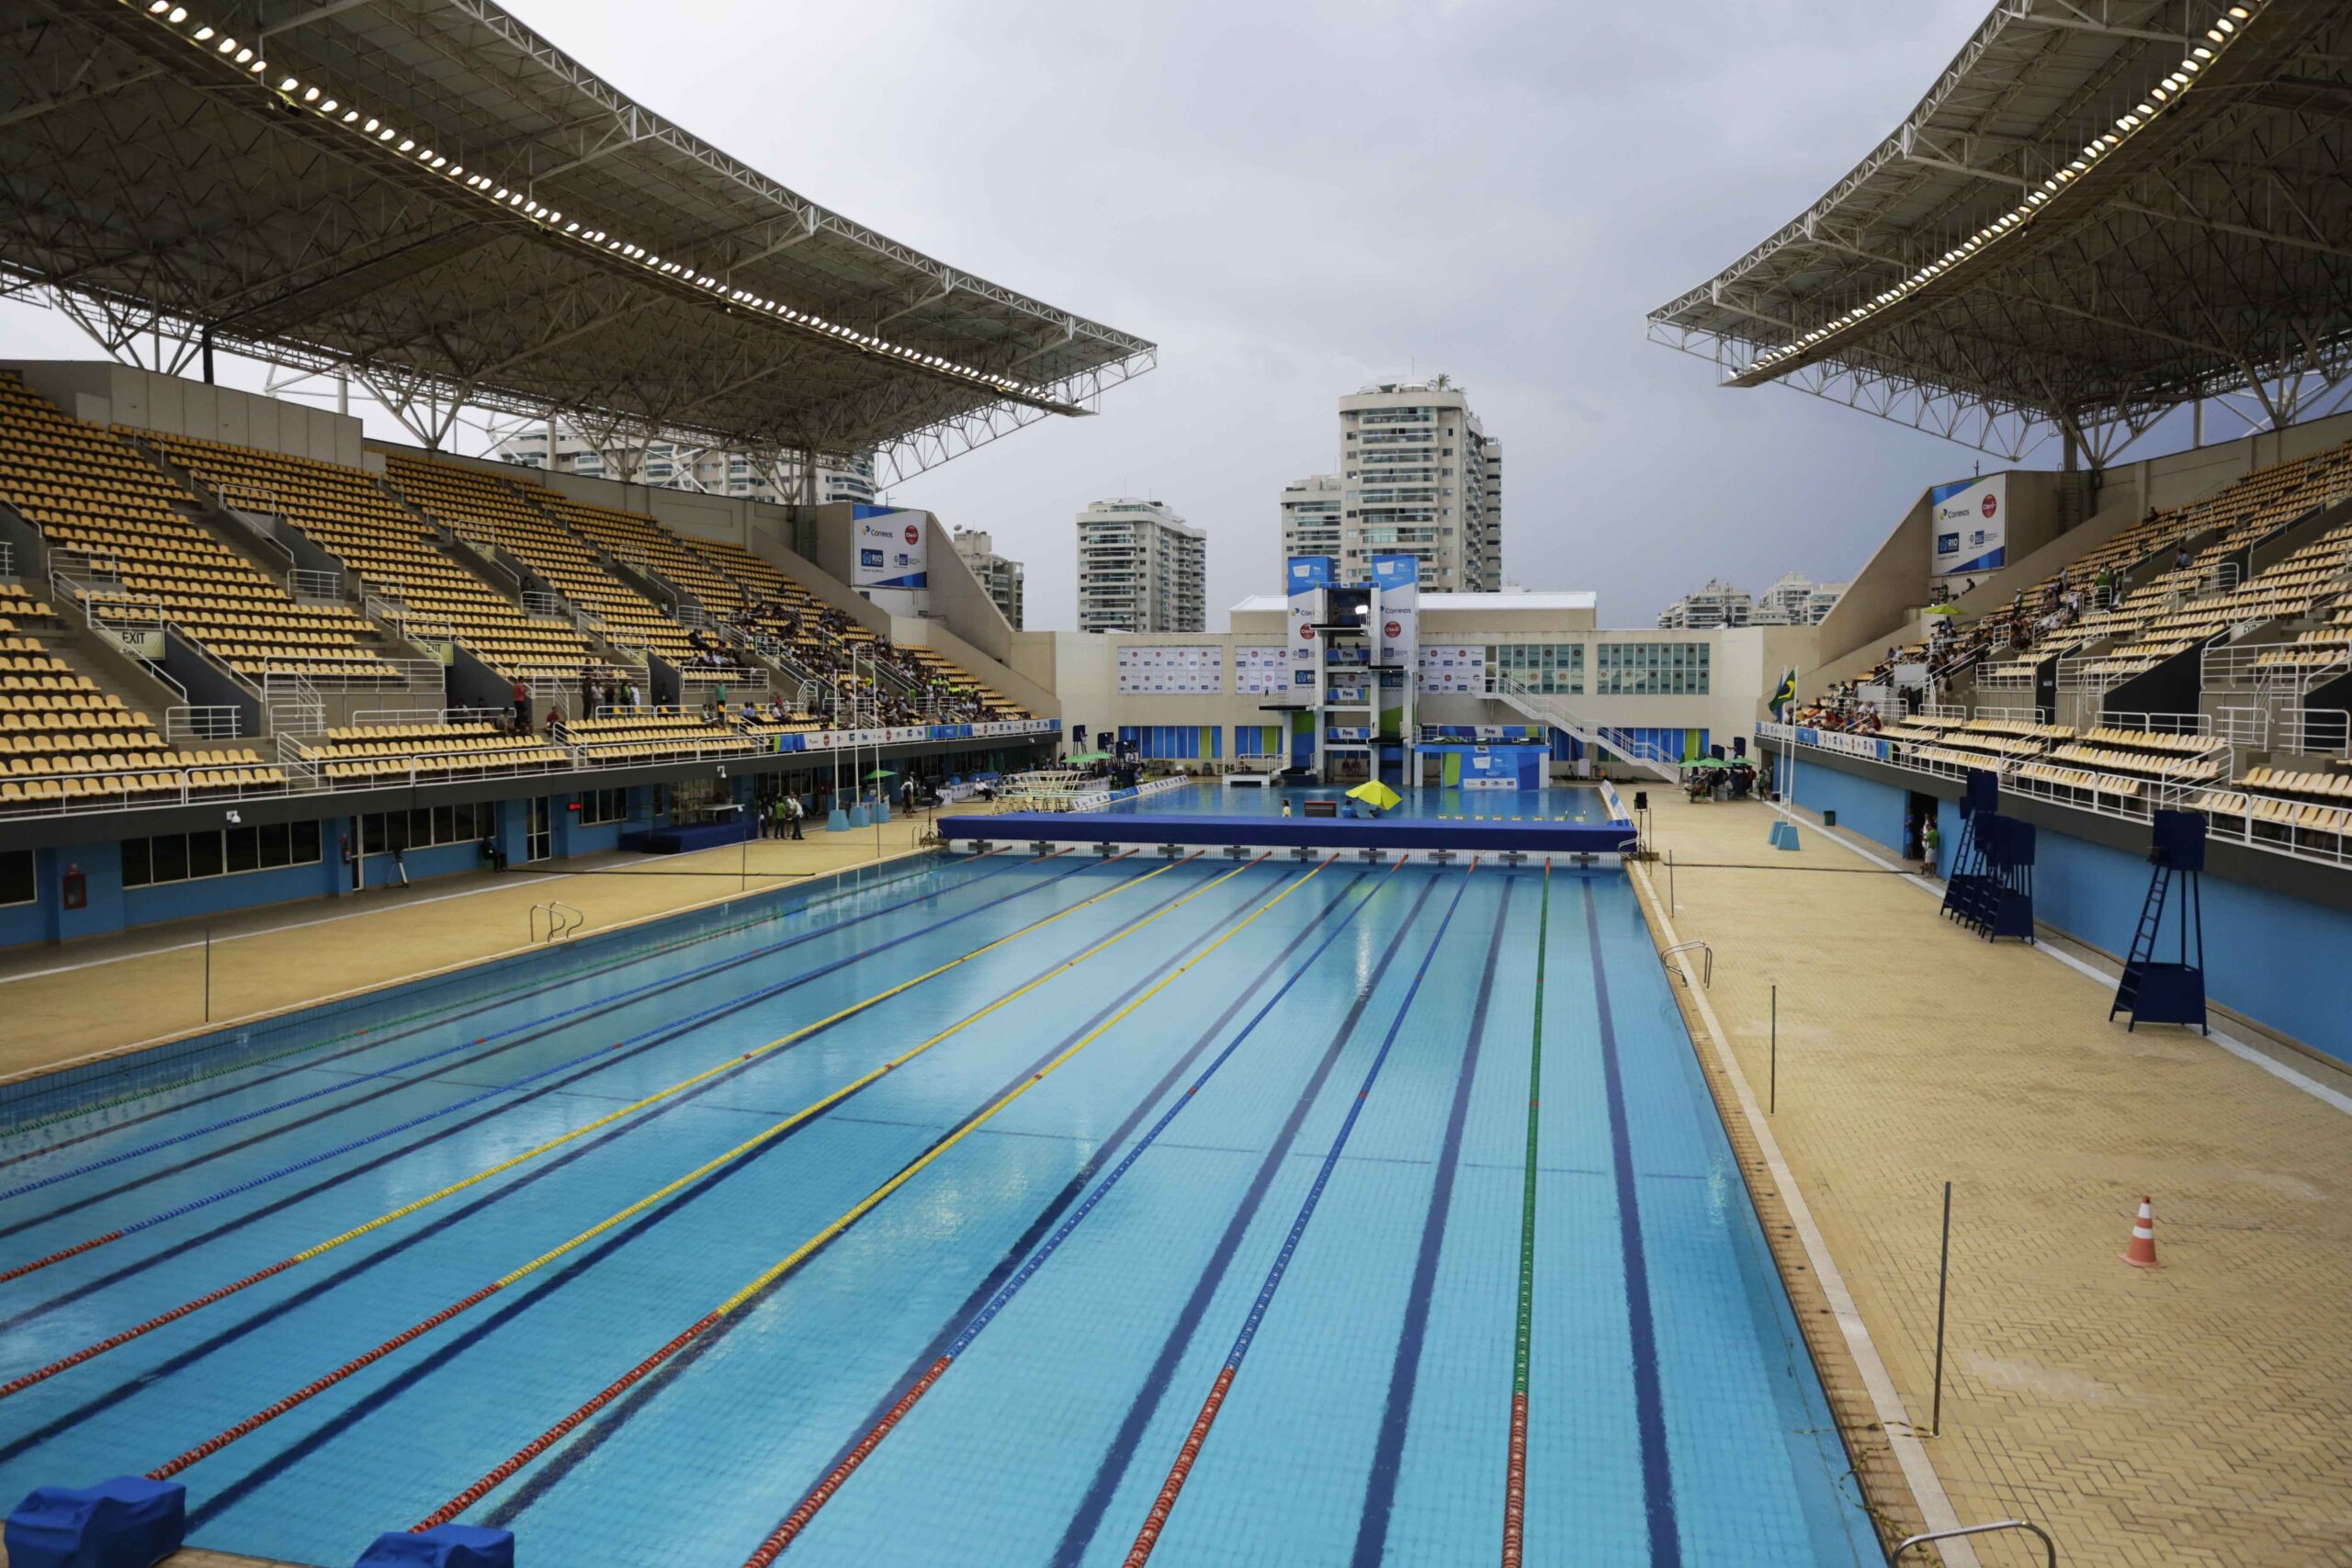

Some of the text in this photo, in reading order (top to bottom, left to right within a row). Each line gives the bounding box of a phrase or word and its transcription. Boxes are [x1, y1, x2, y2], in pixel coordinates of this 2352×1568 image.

[1948, 509, 1970, 519] Correios
[871, 529, 893, 538] Correios
[1948, 538, 1958, 547] RIO
[122, 632, 145, 644] EXIT
